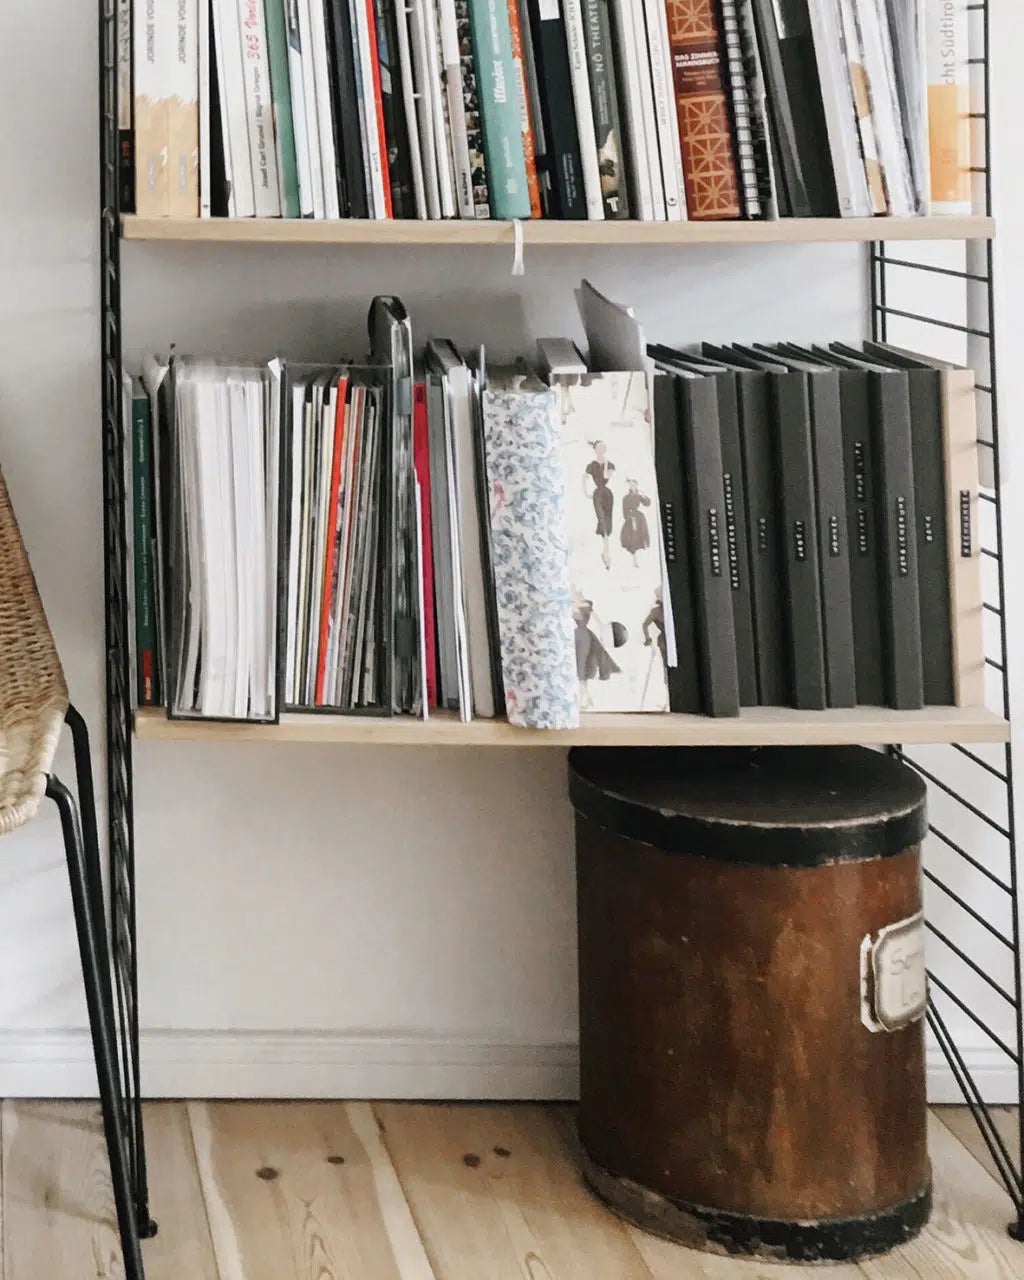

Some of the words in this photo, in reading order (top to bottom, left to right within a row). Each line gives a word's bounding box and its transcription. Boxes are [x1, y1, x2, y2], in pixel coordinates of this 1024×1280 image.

[146, 23, 154, 63] JORINDE
[178, 23, 186, 63] JORINDE
[245, 33, 260, 60] 365
